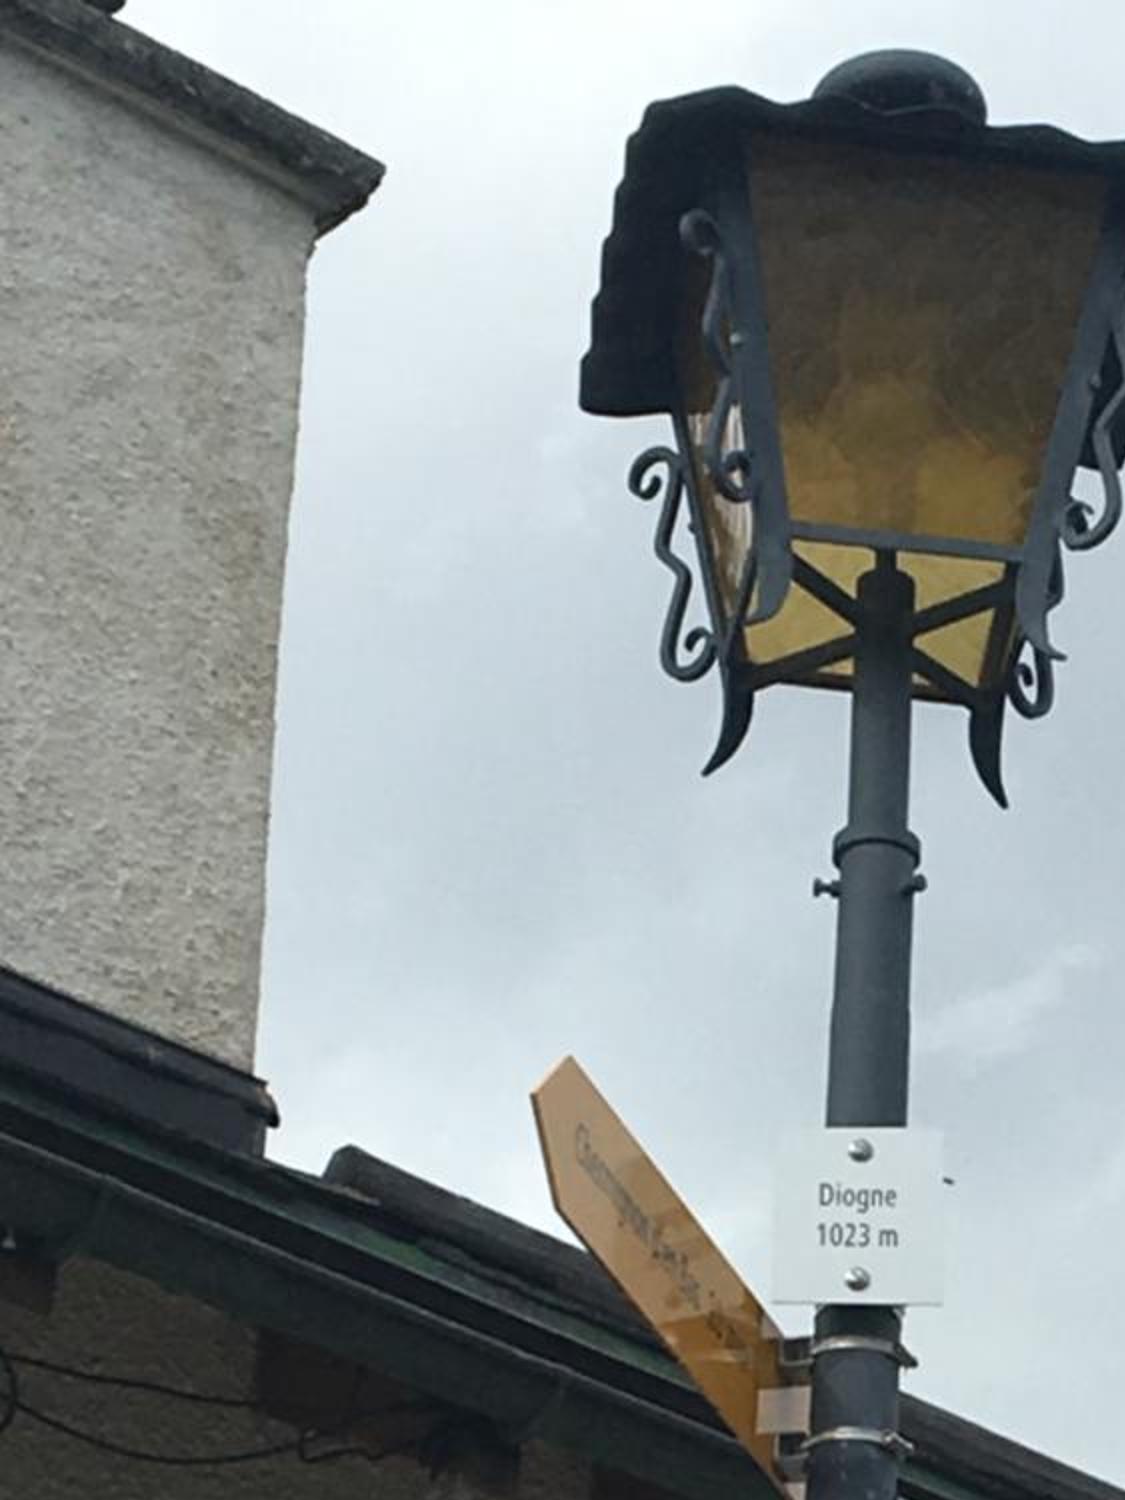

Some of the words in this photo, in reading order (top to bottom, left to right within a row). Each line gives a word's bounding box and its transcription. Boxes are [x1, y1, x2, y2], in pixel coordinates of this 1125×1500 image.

[819, 1183, 897, 1213] Diogne
[818, 1223, 870, 1248] 1023
[879, 1229, 899, 1248] m
